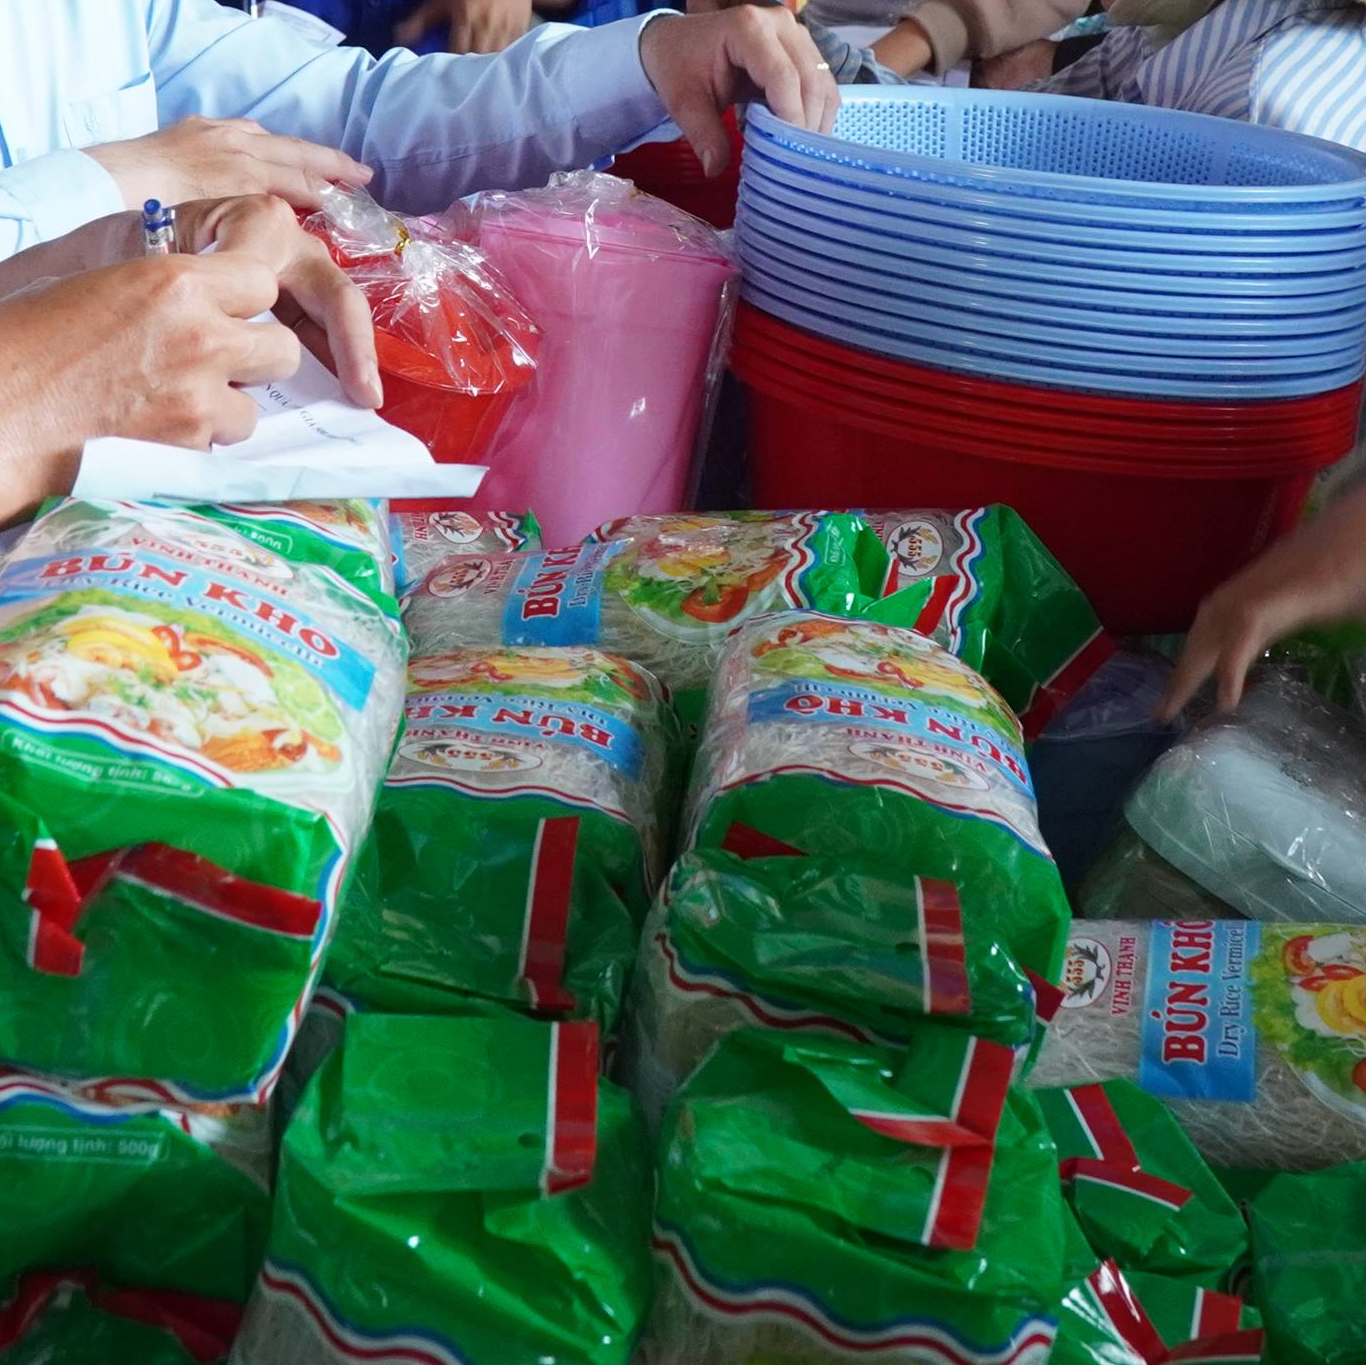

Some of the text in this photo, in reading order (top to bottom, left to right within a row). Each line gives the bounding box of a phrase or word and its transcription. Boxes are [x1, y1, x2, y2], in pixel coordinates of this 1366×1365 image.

[39, 552, 189, 588] BÚN
[517, 545, 583, 620] BÚN KH
[405, 704, 615, 748] BÚN KH
[927, 718, 1028, 785] BÚN
[1150, 981, 1209, 1063] BÚN
[1219, 985, 1243, 1019] Rice
[1218, 1021, 1247, 1057] Dry
